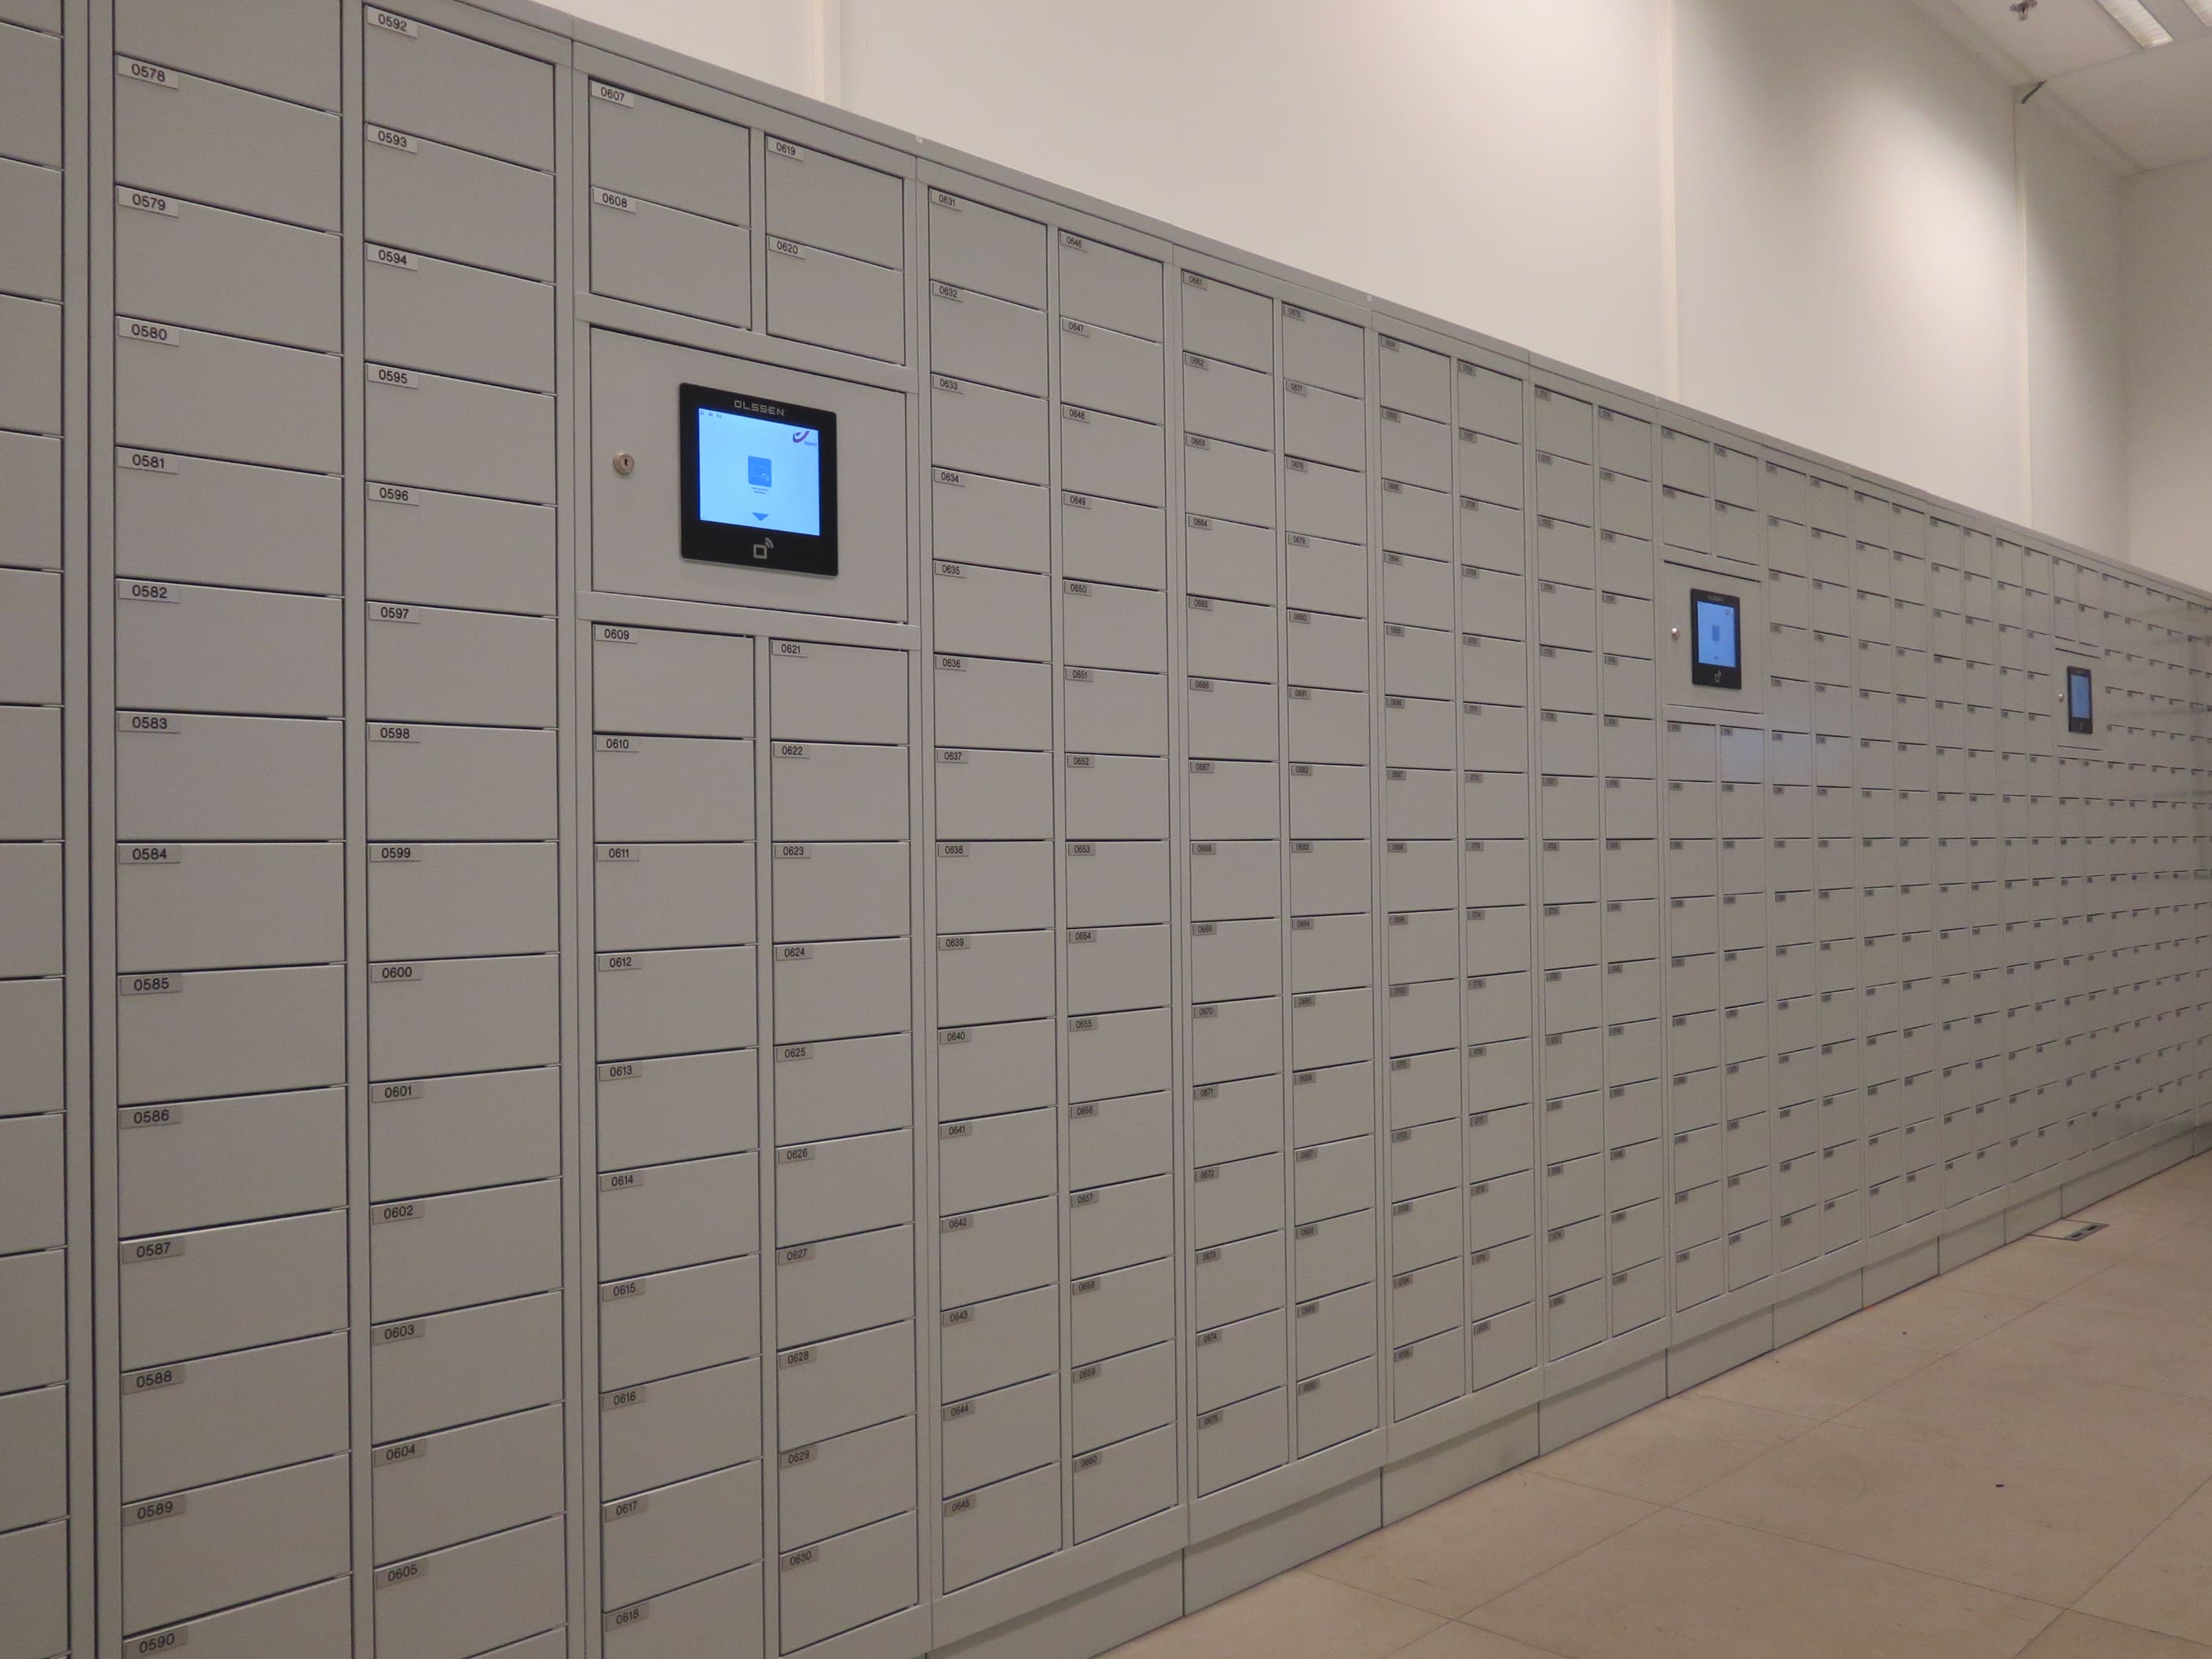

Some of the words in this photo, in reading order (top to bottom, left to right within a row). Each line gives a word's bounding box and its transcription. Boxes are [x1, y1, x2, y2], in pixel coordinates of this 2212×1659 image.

[379, 13, 407, 31] 0592
[132, 64, 165, 82] 0578
[601, 87, 624, 101] 0607
[379, 130, 407, 148] 0593
[776, 142, 796, 156] 0619
[133, 194, 166, 211] 0579
[602, 193, 628, 208] 0608
[939, 194, 955, 207] 0631
[777, 241, 798, 255] 0620
[379, 250, 407, 265] 0594
[939, 286, 958, 298] 0632
[132, 324, 167, 340] 0580
[379, 369, 408, 384] 0595
[940, 379, 958, 390] 0633
[734, 400, 786, 416] OLSSEN
[133, 454, 164, 468] 0581
[942, 472, 958, 482] 0634
[379, 488, 408, 501] 0596
[943, 565, 960, 574] 0635
[132, 585, 167, 599] 0582
[381, 607, 409, 619] 0597
[605, 629, 629, 639] 0609
[782, 644, 800, 654] 0621
[943, 658, 961, 668] 0636
[132, 716, 167, 729] 0583
[380, 727, 409, 738] 0598
[606, 738, 629, 749] 0610
[782, 745, 803, 756] 0622
[944, 752, 961, 760] 0637
[133, 848, 167, 859] 0584
[382, 848, 411, 858] 0599
[609, 848, 629, 858] 0611
[783, 846, 804, 855] 0623
[945, 845, 963, 854] 0638
[946, 938, 964, 947] 0639
[784, 947, 804, 957] 0624
[610, 957, 632, 968] 0612
[383, 967, 412, 979] 0600
[134, 978, 170, 991] 0585
[947, 1031, 965, 1041] 0640
[785, 1048, 806, 1058] 0625
[610, 1065, 632, 1077] 0613
[385, 1086, 412, 1098] 0601
[134, 1110, 170, 1123] 0586
[949, 1125, 965, 1135] 0641
[787, 1148, 808, 1159] 0626
[612, 1175, 633, 1186] 0614
[384, 1206, 413, 1219] 0602
[950, 1218, 966, 1229] 0642
[137, 1242, 171, 1258] 0587
[787, 1250, 807, 1261] 0627
[613, 1284, 635, 1296] 0615
[950, 1310, 968, 1322] 0643
[385, 1325, 414, 1339] 0603
[788, 1351, 809, 1364] 0628
[137, 1371, 172, 1388] 0588
[613, 1392, 635, 1405] 0616
[951, 1404, 968, 1416] 0644
[386, 1444, 416, 1461] 0604
[789, 1450, 809, 1464] 0629
[138, 1501, 173, 1519] 0589
[617, 1501, 638, 1515] 0617
[952, 1500, 969, 1511] 0645
[790, 1551, 811, 1566] 0630
[388, 1565, 418, 1582] 0605
[617, 1609, 639, 1625] 0618
[139, 1633, 174, 1653] 0590
